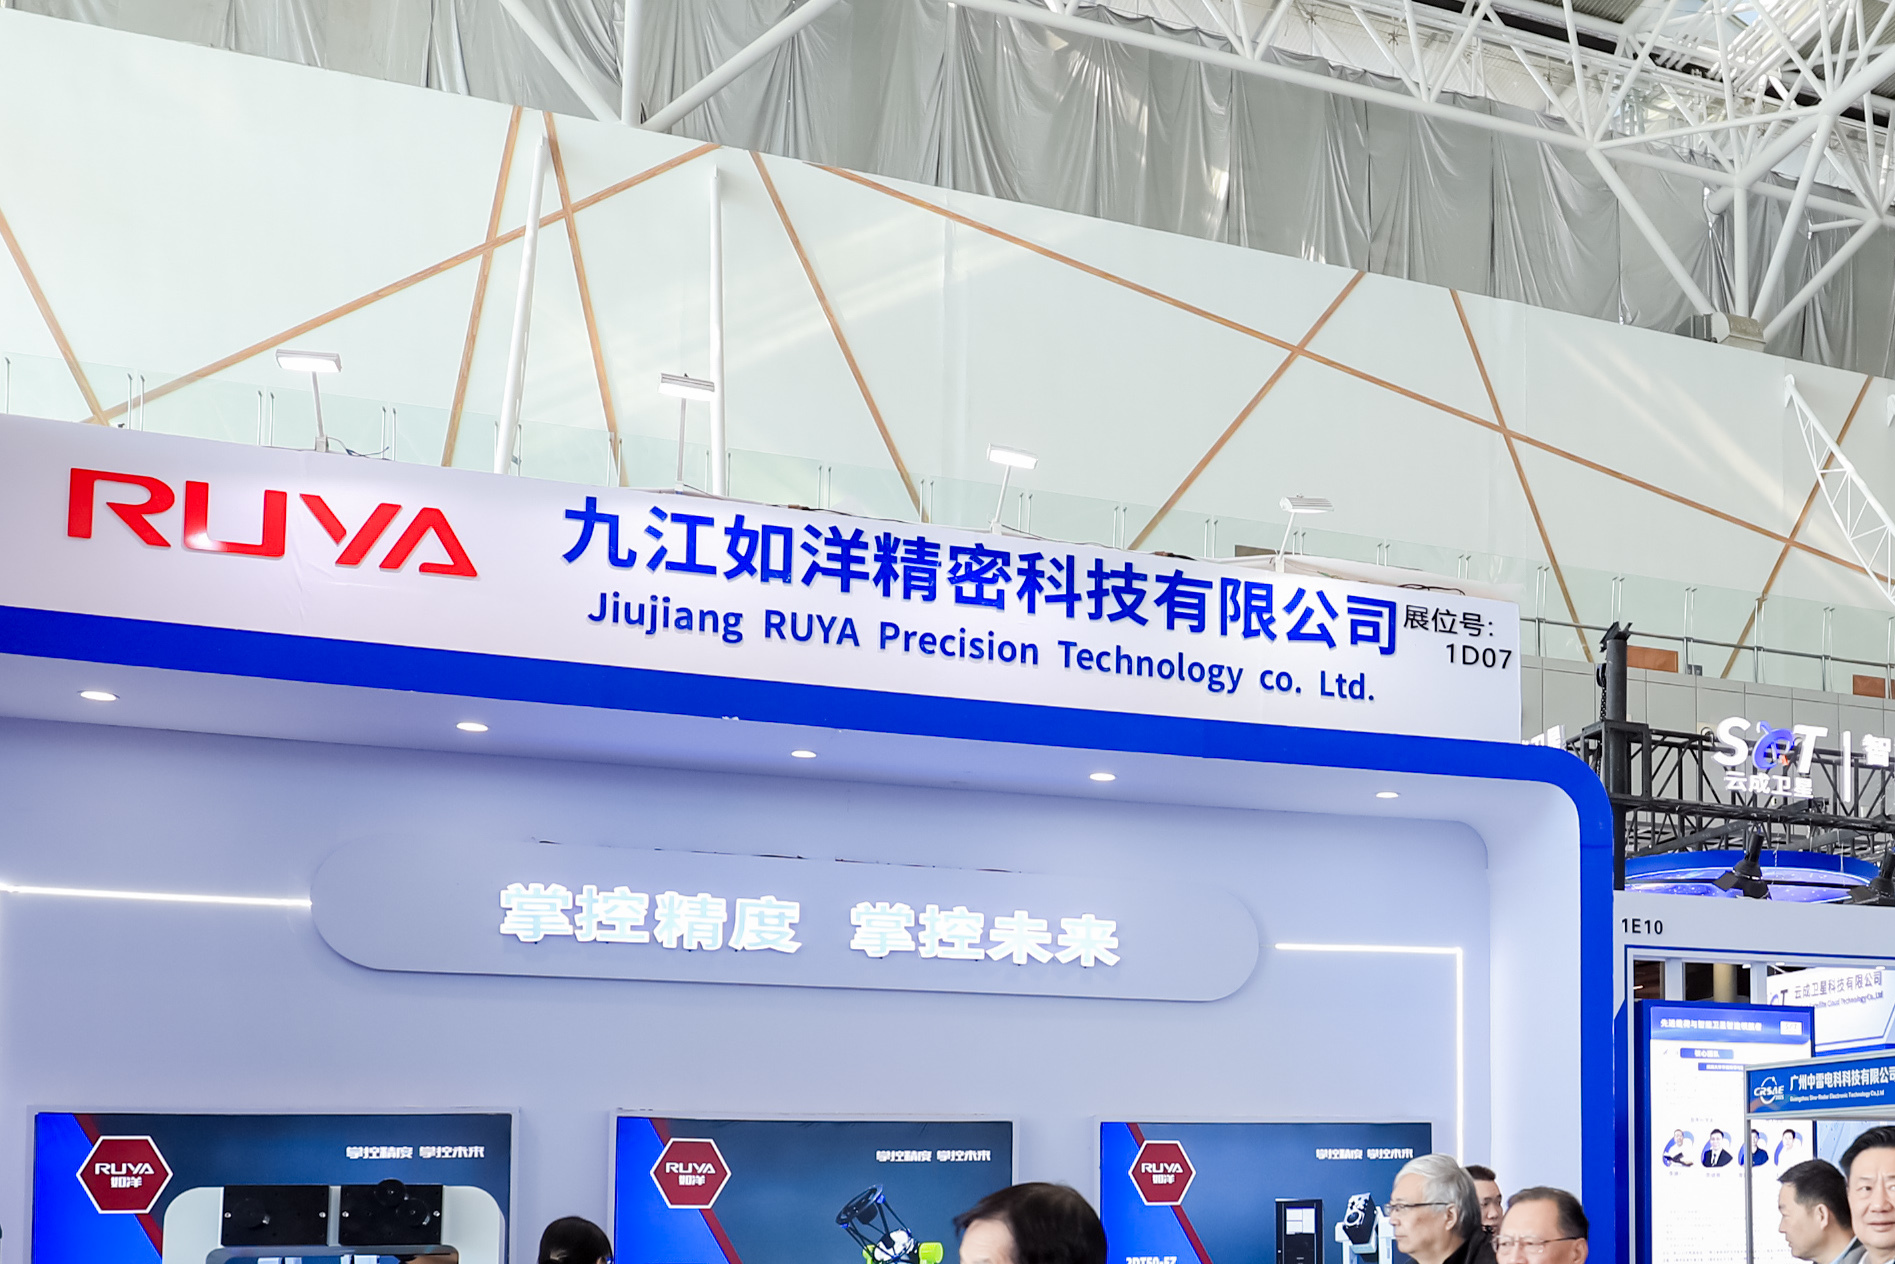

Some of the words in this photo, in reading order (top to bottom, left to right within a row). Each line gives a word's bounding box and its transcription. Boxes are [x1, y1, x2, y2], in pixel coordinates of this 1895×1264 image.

[67, 467, 478, 577] RUYA
[563, 495, 1397, 655] 九江如洋精密科技有限公司
[1402, 604, 1496, 638] 展位号：
[587, 592, 744, 644] Jiujiang
[764, 609, 860, 648] RUYA
[879, 622, 1040, 667] Precision
[1058, 639, 1244, 695] Technology
[1259, 666, 1302, 695] co.
[1319, 670, 1376, 702] Ltd.
[1445, 641, 1513, 670] 1D07
[1722, 770, 1815, 799] 云成卫星
[500, 881, 802, 956] 掌控精度
[850, 899, 1121, 967] 掌控未来
[1620, 917, 1664, 936] 1E10
[1794, 970, 1883, 1000] 云成卫星科技有限公司
[1753, 1083, 1785, 1097] CRSAE
[345, 1145, 414, 1161] 掌控精度
[418, 1144, 485, 1160] 掌控未来
[95, 1162, 155, 1176] RUYA
[665, 1161, 716, 1174] RUYA
[1141, 1162, 1184, 1174] RUYA
[110, 1176, 143, 1188] 如洋
[678, 1174, 706, 1186] 如洋
[1151, 1173, 1175, 1185] 如洋
